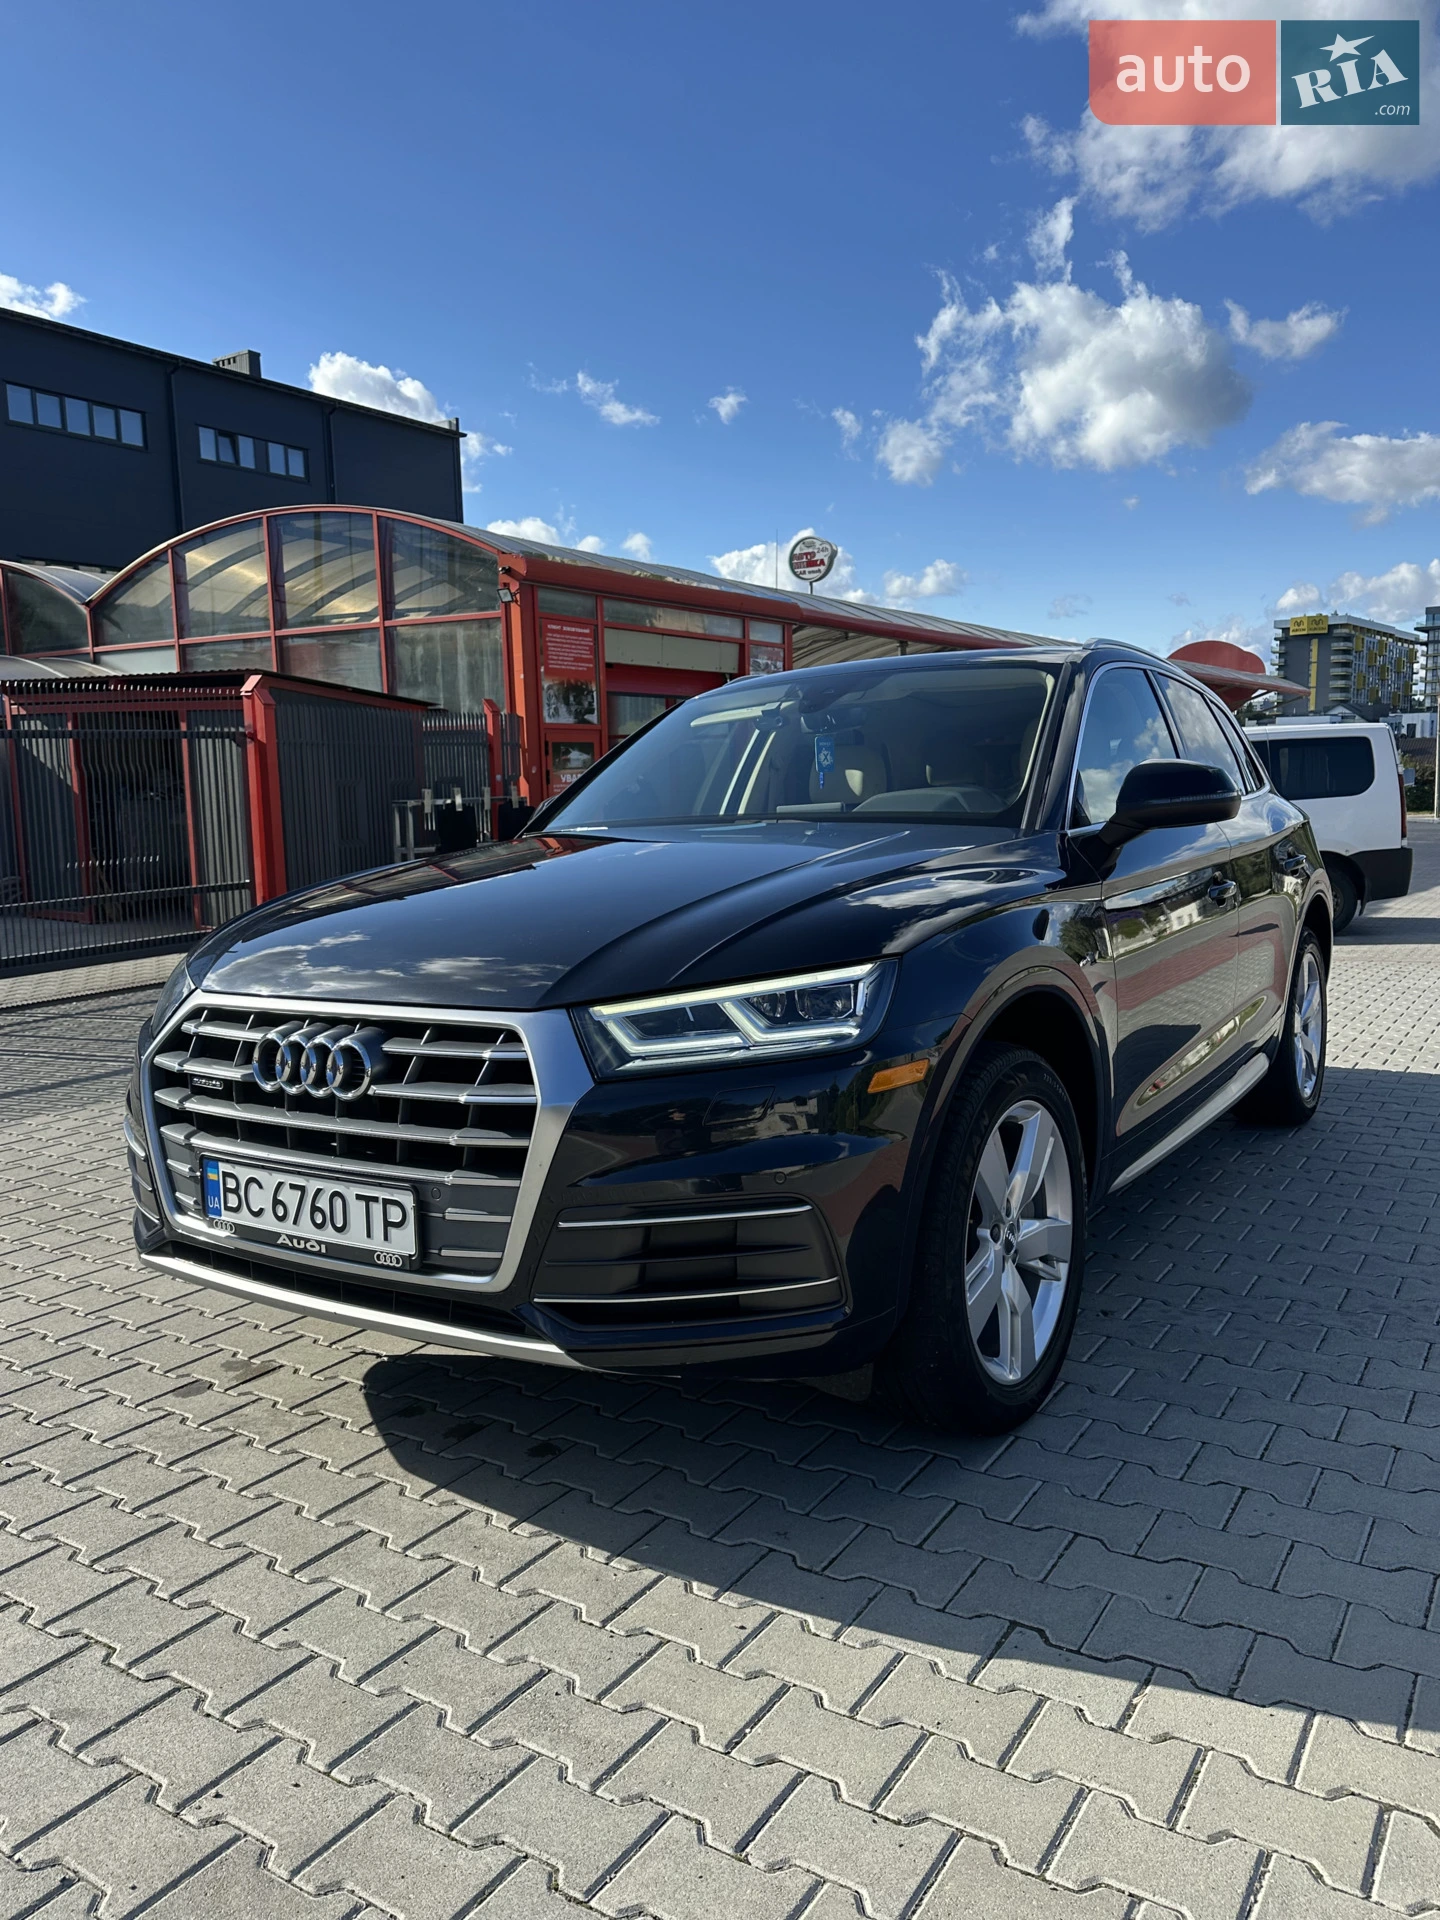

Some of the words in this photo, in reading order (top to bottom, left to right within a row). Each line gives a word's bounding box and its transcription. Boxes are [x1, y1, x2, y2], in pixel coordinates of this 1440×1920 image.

[207, 1195, 220, 1209] UA
[222, 1170, 265, 1218] BC
[271, 1181, 348, 1233] 6760
[355, 1193, 408, 1242] TP
